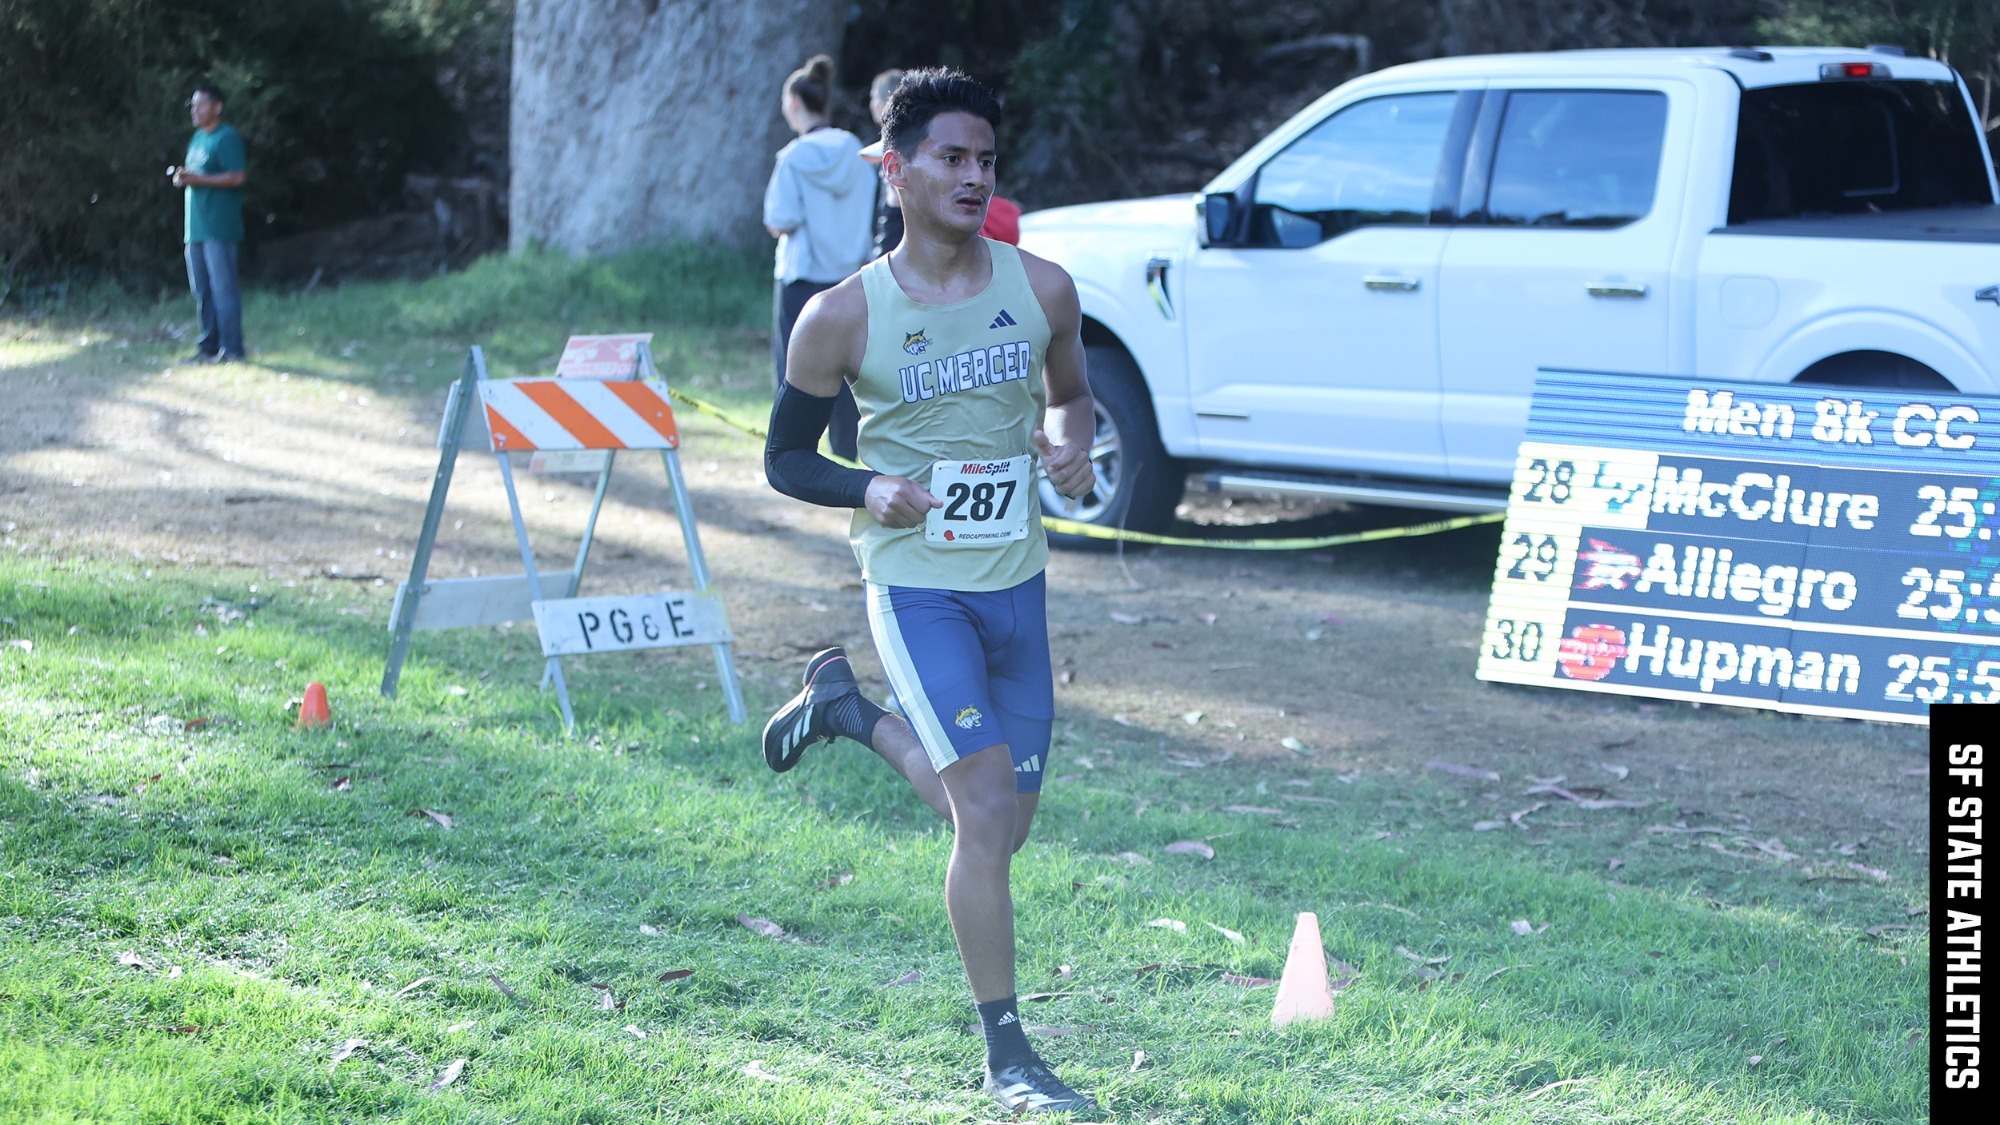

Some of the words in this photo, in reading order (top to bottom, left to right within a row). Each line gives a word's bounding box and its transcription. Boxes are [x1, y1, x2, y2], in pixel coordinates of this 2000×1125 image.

[899, 361, 935, 403] UC
[935, 340, 1030, 396] MERCED
[1682, 388, 1797, 438] Men
[1811, 398, 1879, 445] 8k
[1892, 403, 1980, 449] CC
[960, 461, 1011, 476] MileSplit
[1522, 458, 1575, 504] 28
[1651, 466, 1880, 530] McClure
[1909, 485, 2000, 539] 25:
[943, 480, 1017, 522] 287
[1506, 532, 1557, 582] 29
[1635, 543, 1858, 616] Alliegro
[1492, 619, 1543, 662] 30
[1625, 622, 1861, 695] Hupman
